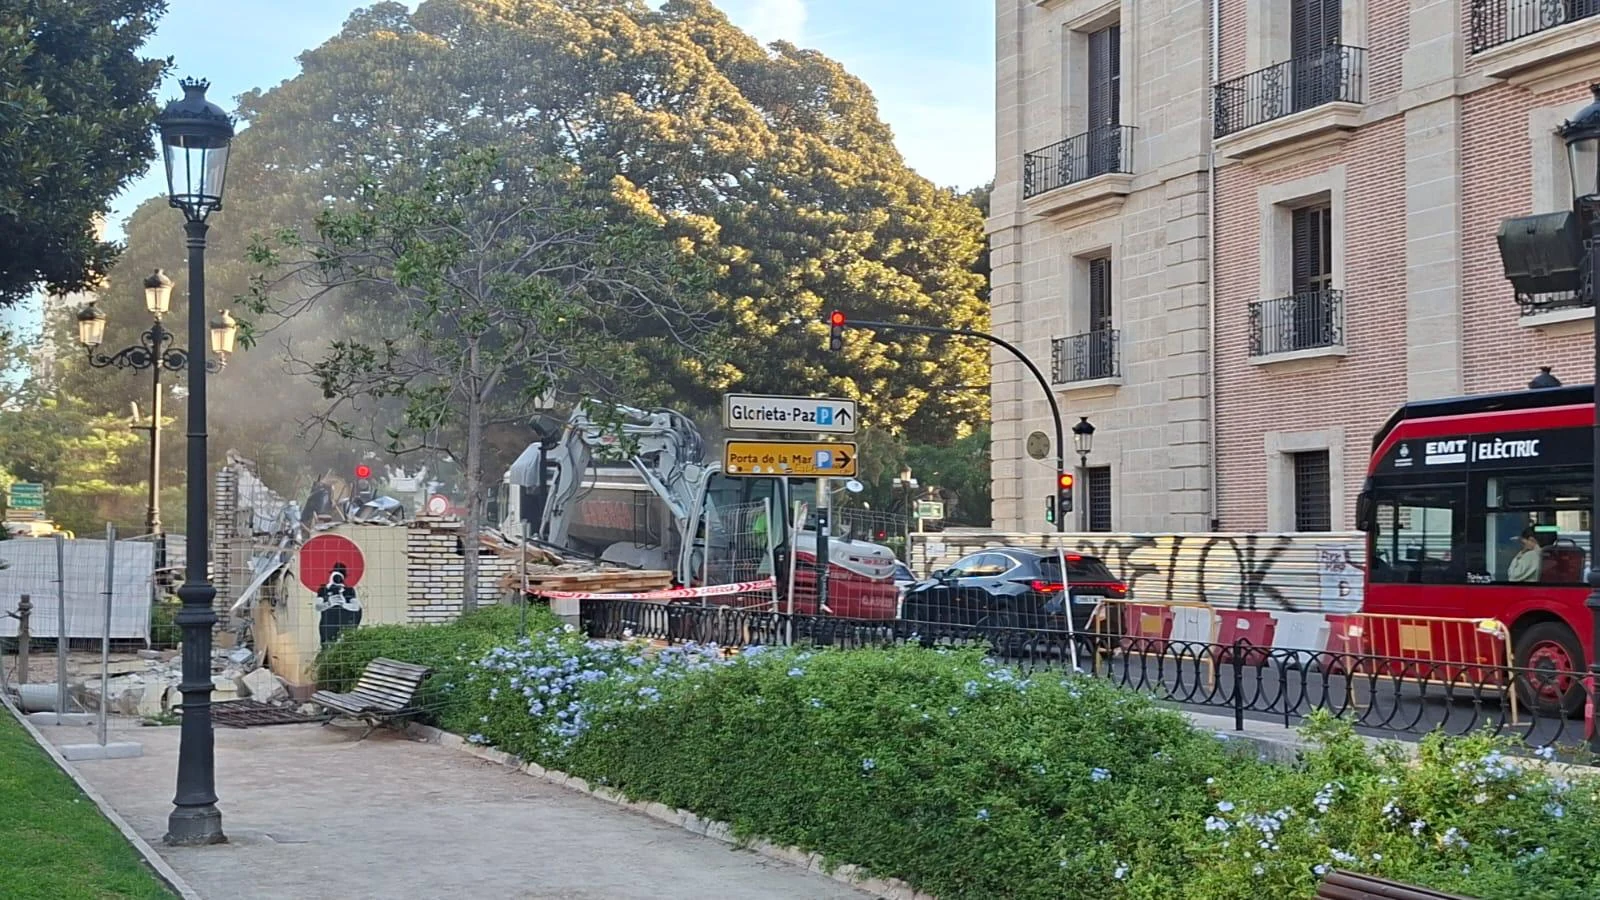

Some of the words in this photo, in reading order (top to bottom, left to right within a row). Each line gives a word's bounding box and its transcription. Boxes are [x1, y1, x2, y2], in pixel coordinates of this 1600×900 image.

[1425, 440, 1467, 454] EMT
[1478, 438, 1540, 460] ELÈCTRIC
[730, 453, 758, 464] Porta
[762, 453, 774, 463] de
[778, 454, 787, 464] la
[792, 454, 812, 463] Mar
